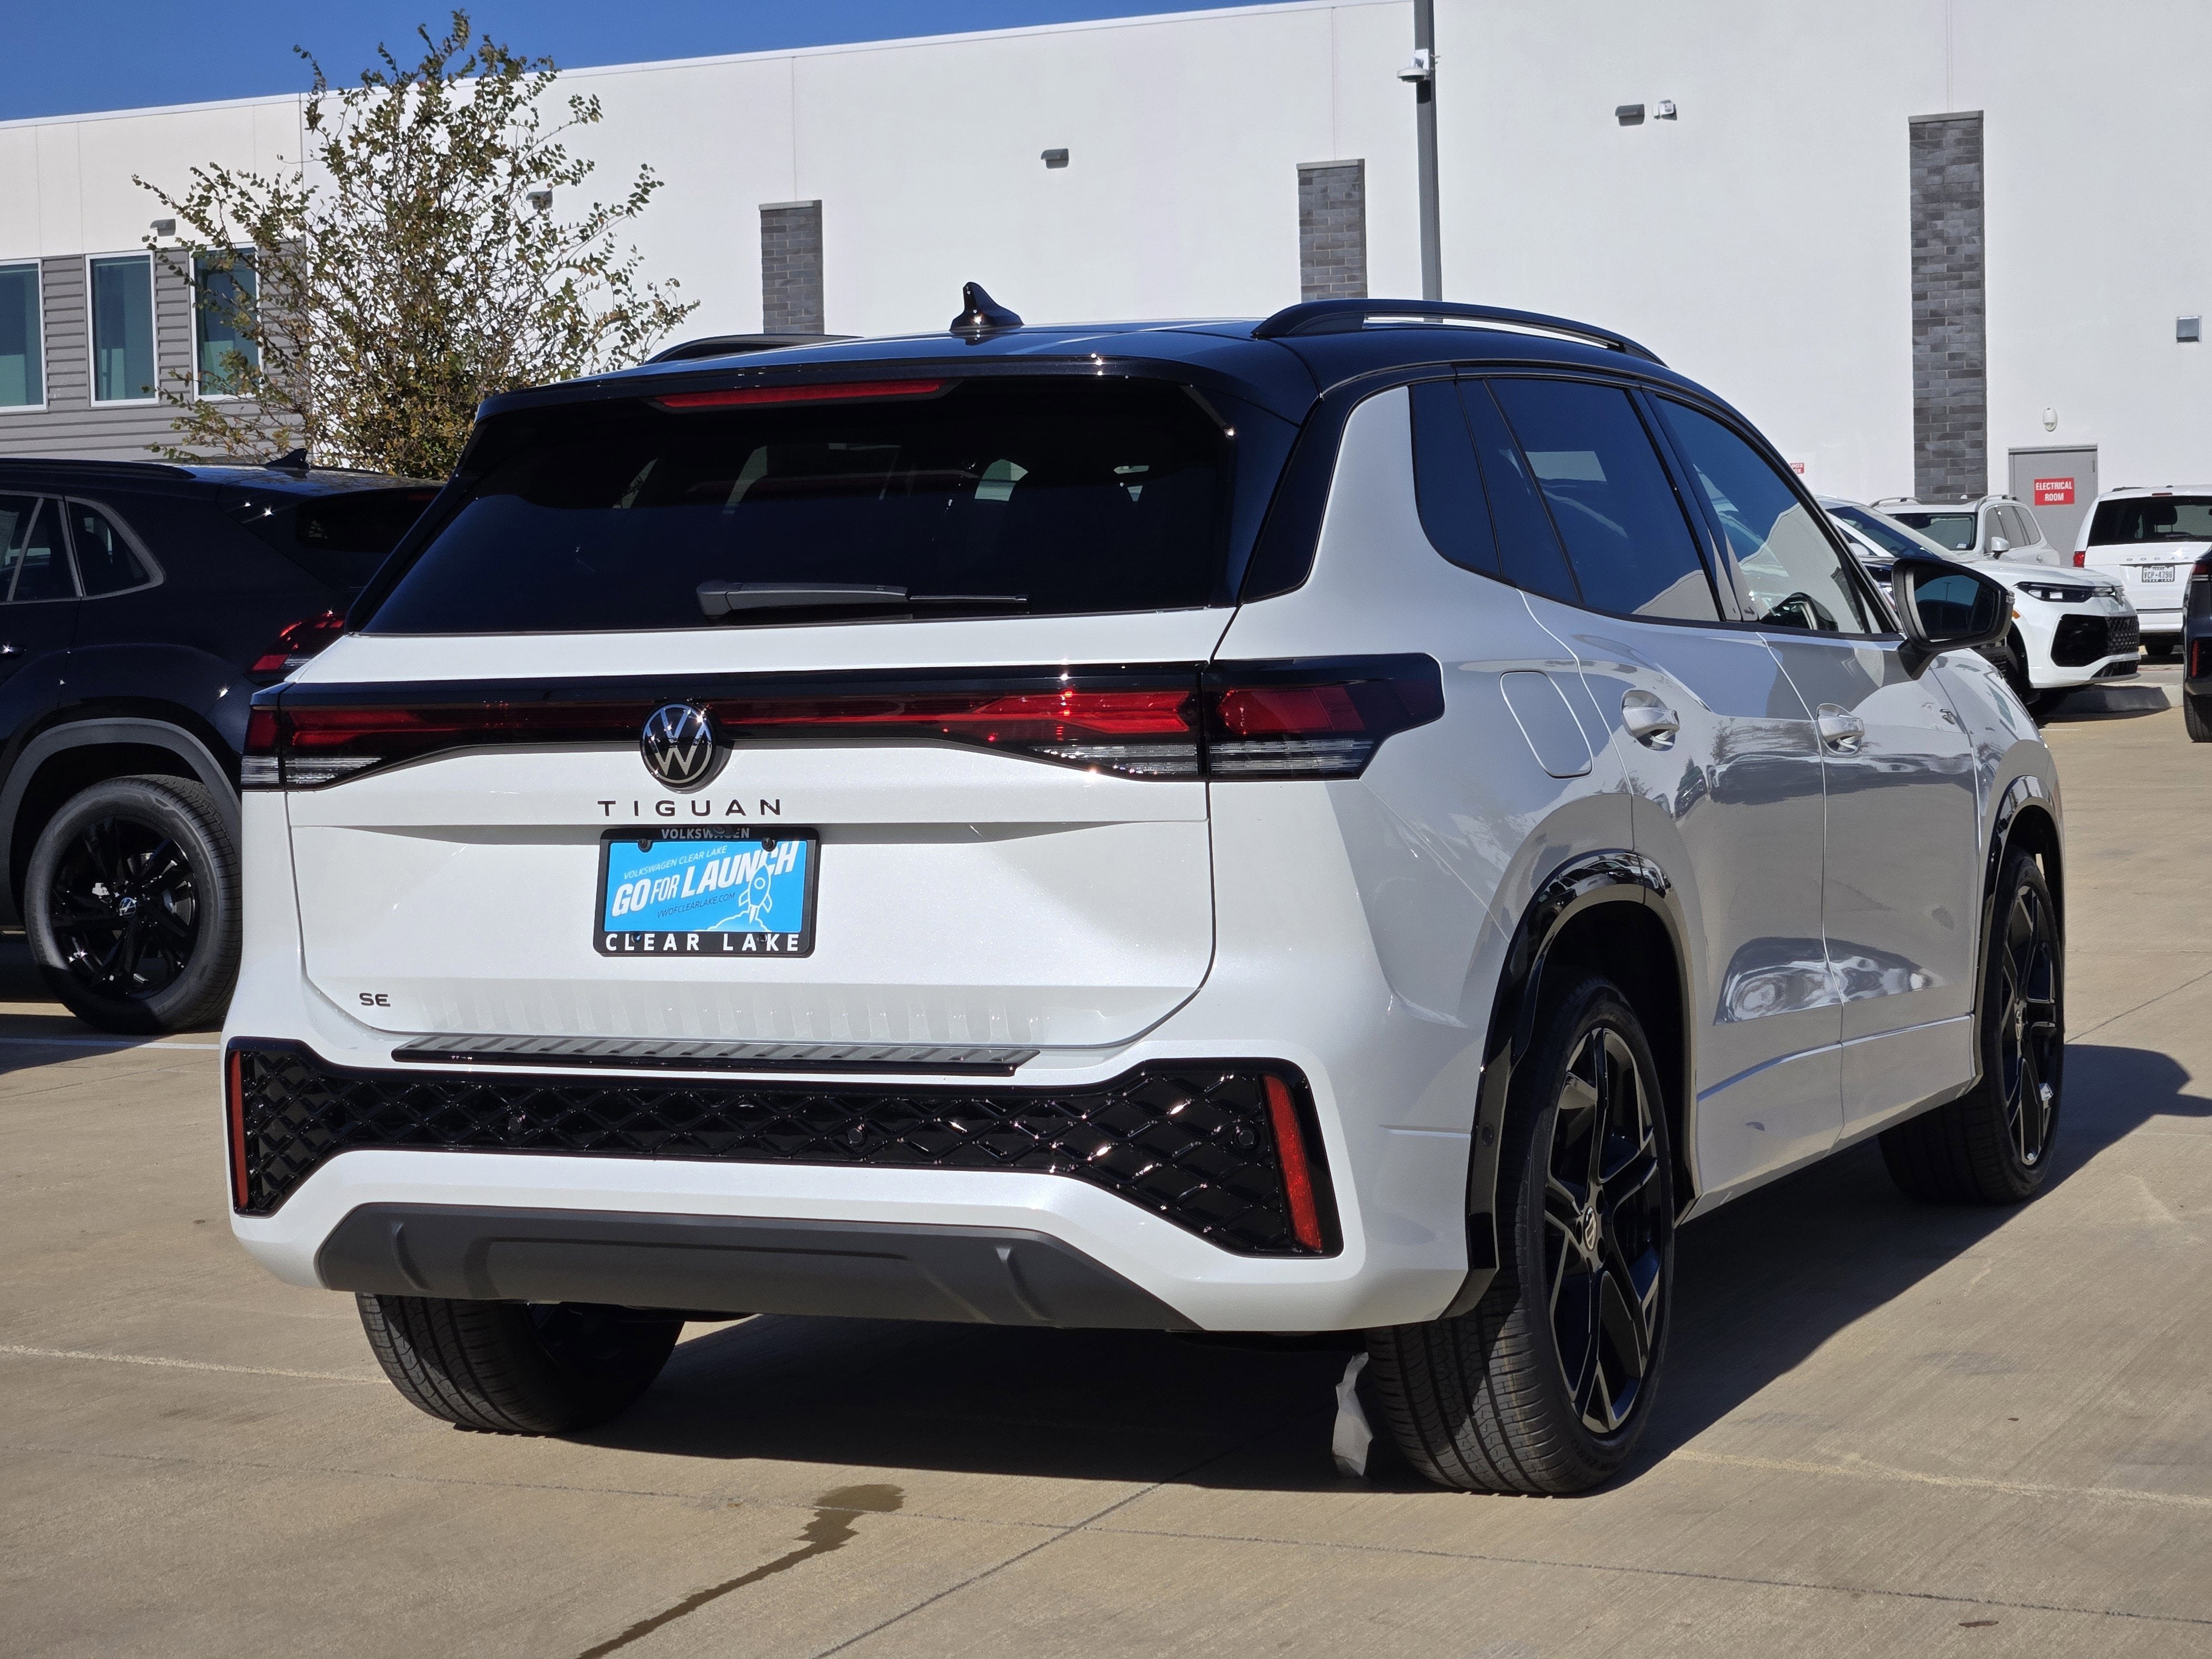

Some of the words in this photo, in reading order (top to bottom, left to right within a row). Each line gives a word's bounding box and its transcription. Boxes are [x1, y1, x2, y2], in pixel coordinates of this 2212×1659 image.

[2036, 481, 2073, 490] ELECTRICAL
[2044, 493, 2064, 501] ROOM
[598, 799, 780, 817] TIGUAN
[661, 828, 749, 839] VOLKSWEN
[624, 858, 677, 880] VOLKSWAGEN
[679, 851, 704, 865] CLEAR
[706, 845, 728, 857] LAKE
[612, 878, 651, 917] GO
[650, 874, 680, 904] FOR
[681, 841, 800, 899] LAUNCH
[657, 892, 735, 918] VWOFCLEARLAKE.COM
[606, 933, 700, 951] CLEAR
[723, 933, 799, 951] LAKE
[359, 993, 390, 1007] SE
